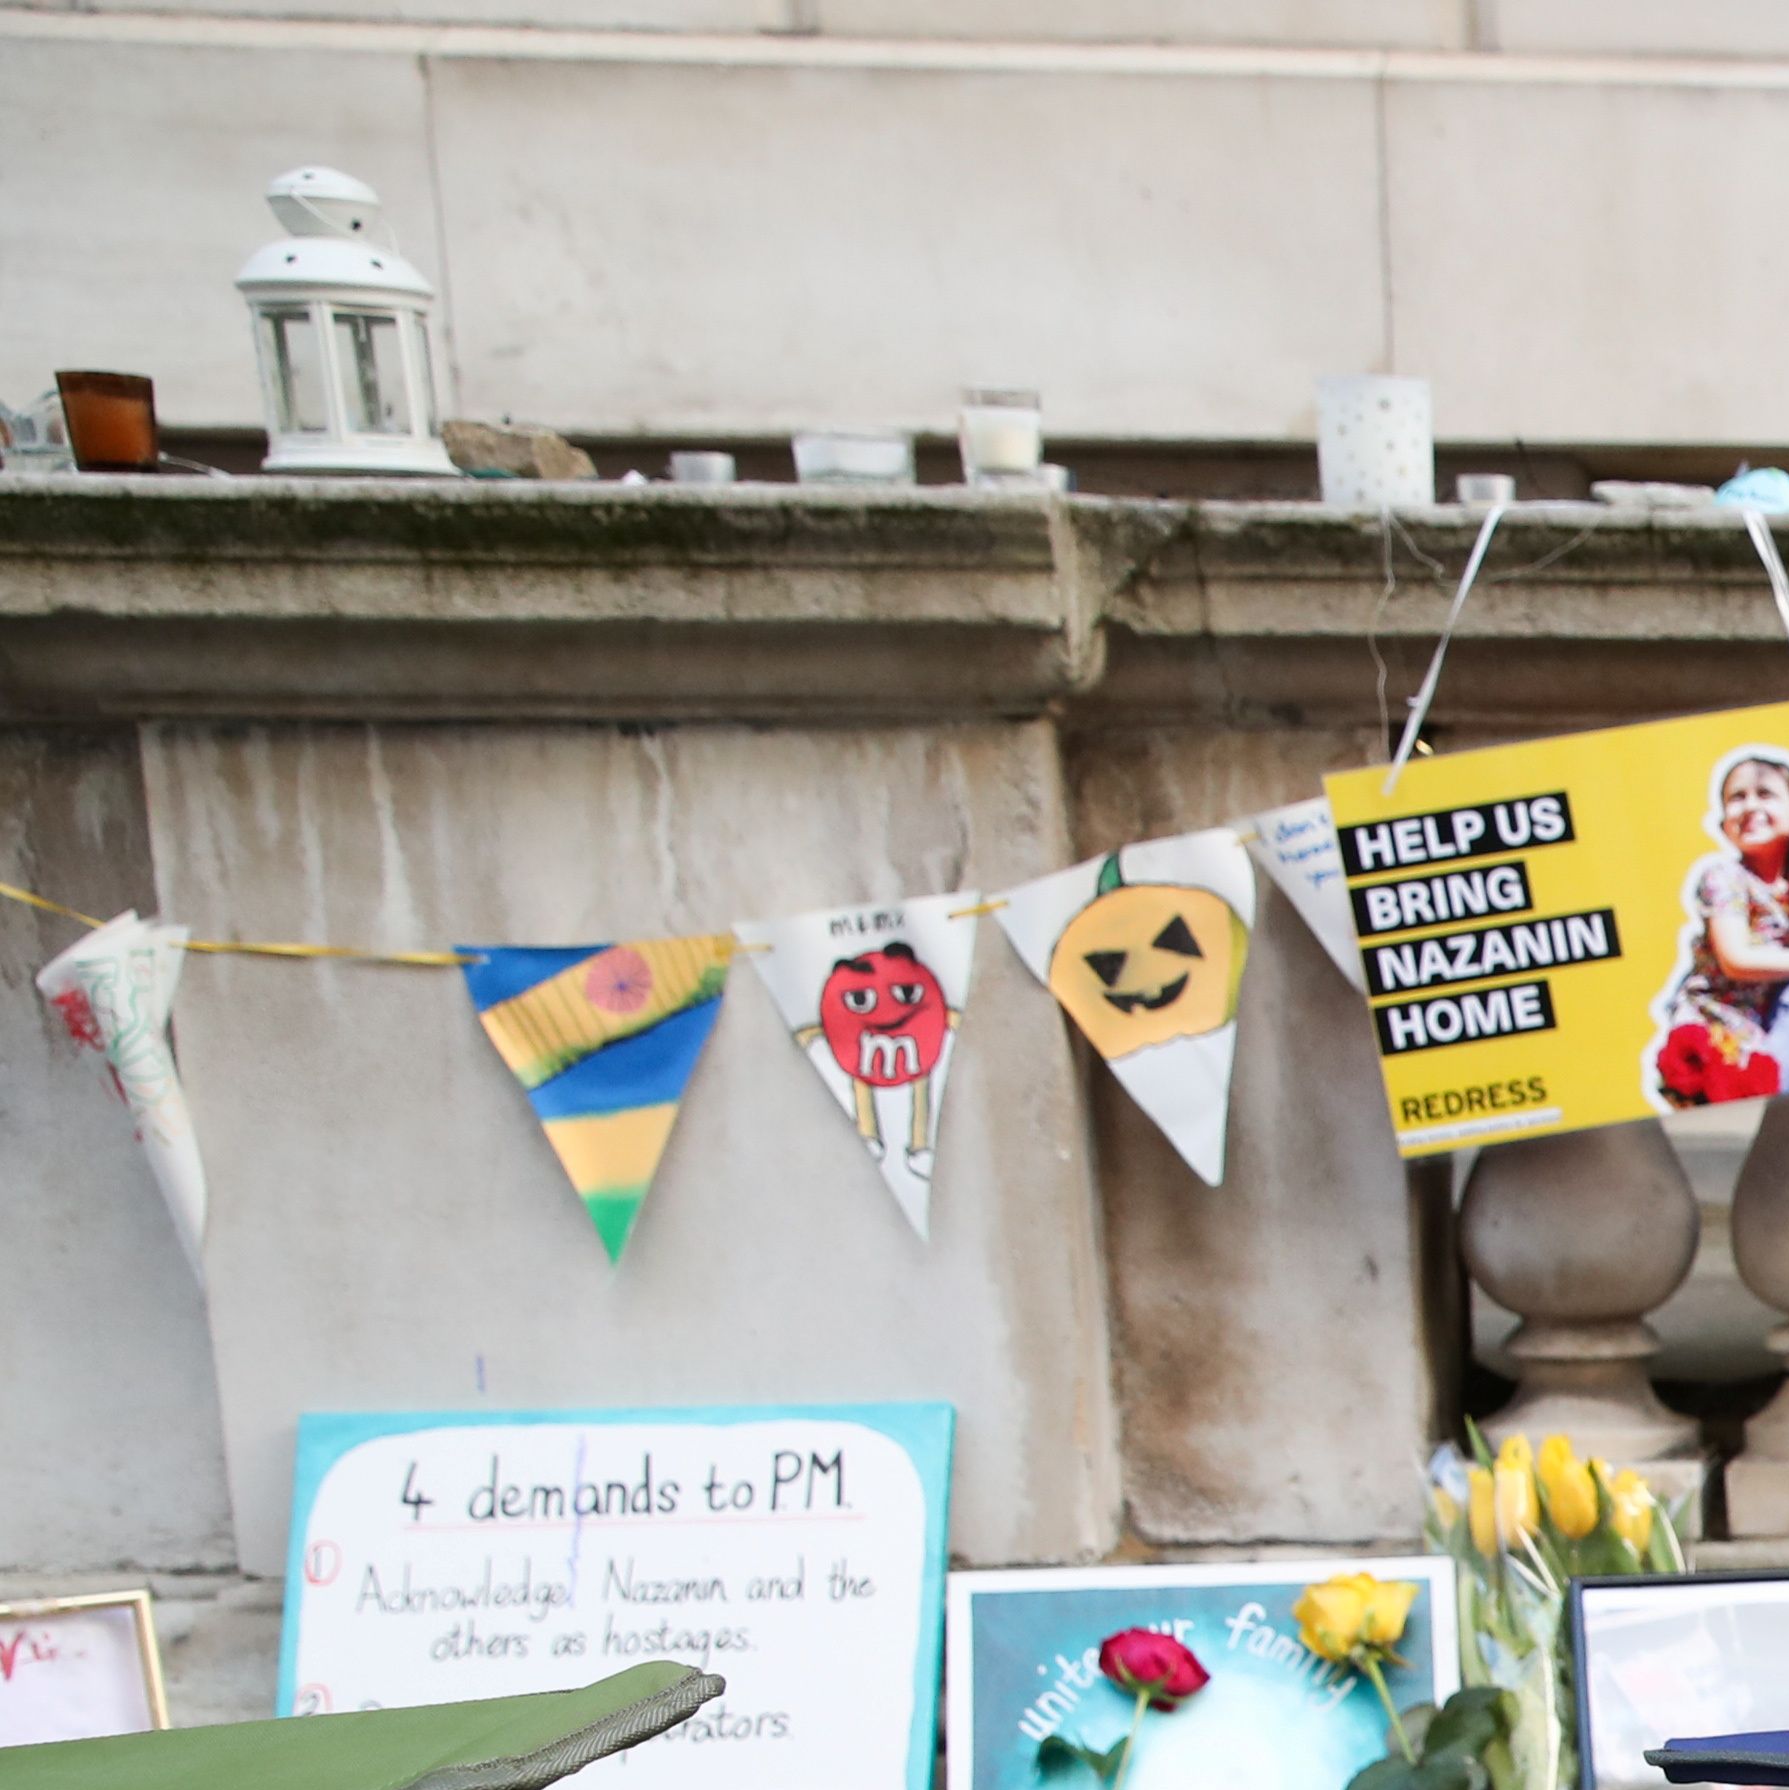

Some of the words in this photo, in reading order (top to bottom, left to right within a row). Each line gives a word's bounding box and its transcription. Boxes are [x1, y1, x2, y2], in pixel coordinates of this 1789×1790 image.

[1356, 810, 1486, 869] HELP
[1496, 798, 1566, 846] US
[1364, 865, 1527, 932] BRING
[1376, 912, 1610, 991] NAZANIN
[1386, 984, 1545, 1050] HOME
[1401, 1075, 1548, 1123] REDRESS
[401, 1460, 435, 1522] 4
[468, 1452, 681, 1521] demands
[703, 1462, 755, 1512] to
[354, 1555, 572, 1622] Acknowledge
[599, 1557, 729, 1605] Nazanin
[745, 1554, 804, 1599] and
[827, 1557, 878, 1599] the
[429, 1620, 531, 1661] others
[551, 1632, 587, 1658] as
